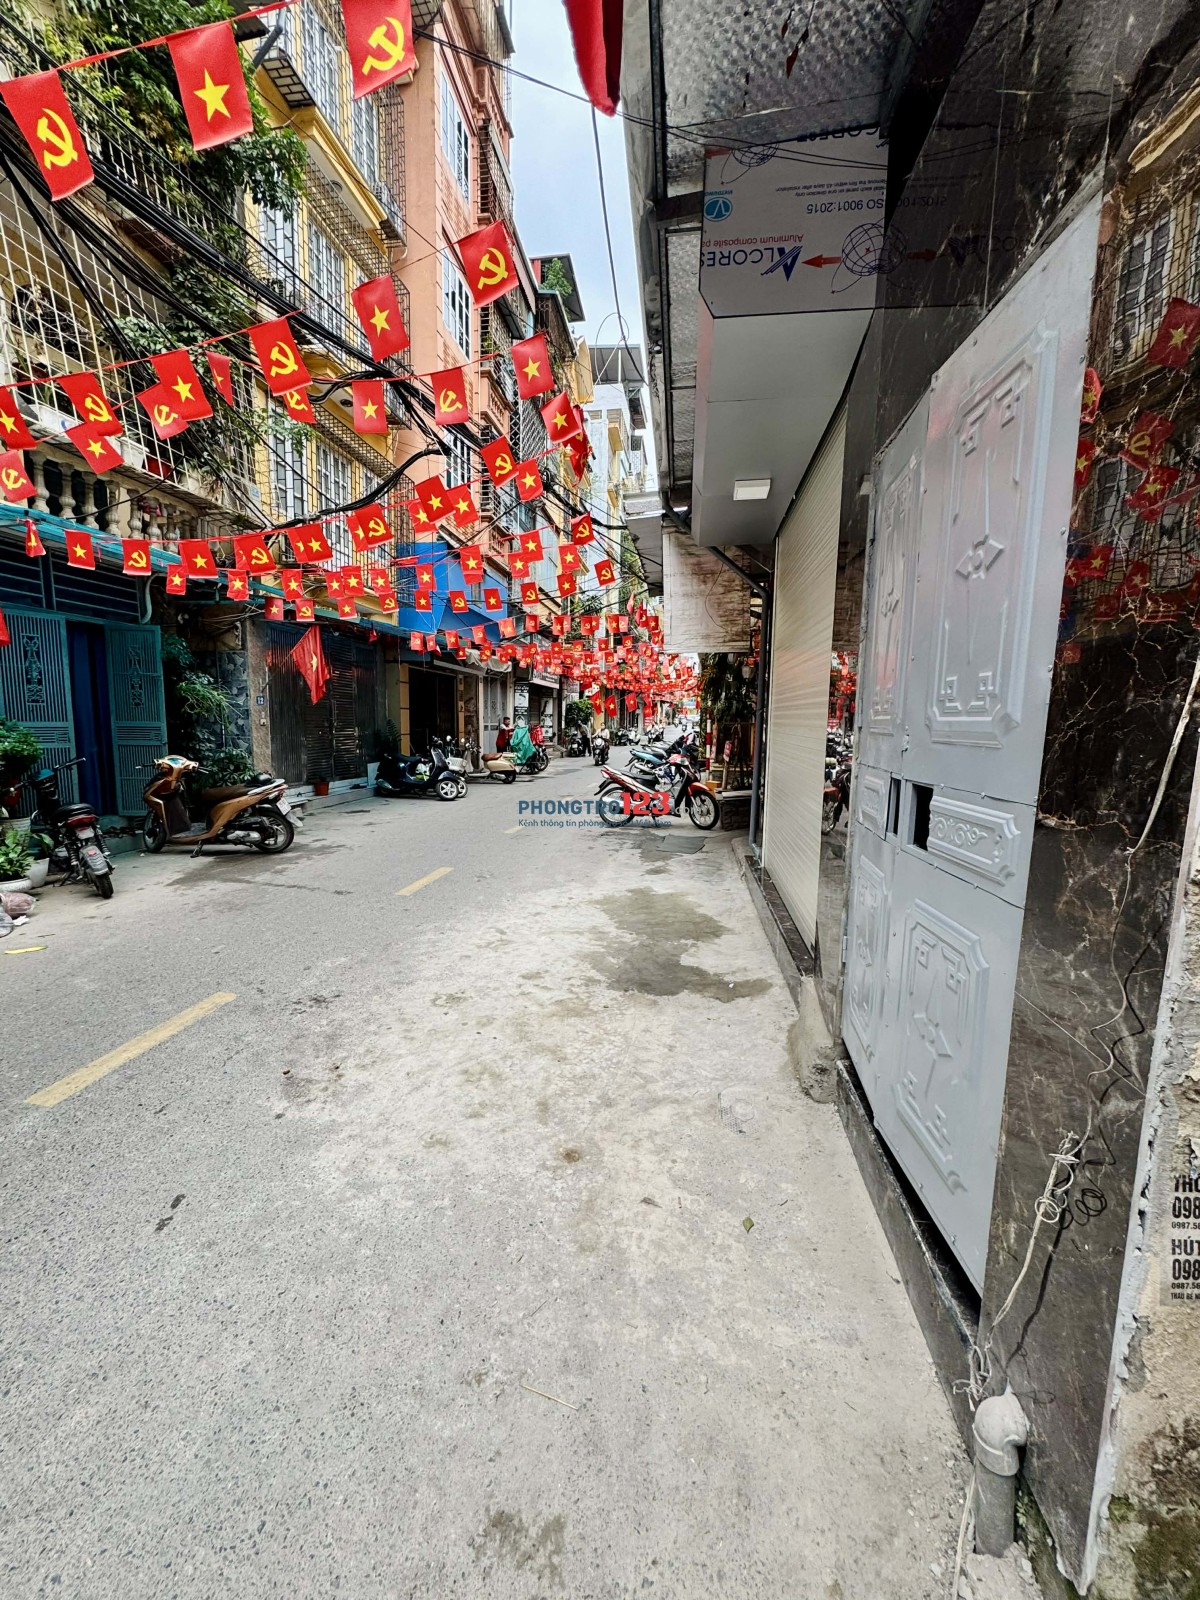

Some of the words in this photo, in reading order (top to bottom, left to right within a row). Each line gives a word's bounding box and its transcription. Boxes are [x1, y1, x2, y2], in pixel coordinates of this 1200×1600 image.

[806, 200, 864, 214] 9001:2015
[713, 237, 758, 248] composite
[760, 234, 804, 244] Aluminum
[1172, 1196, 1200, 1219] 098
[1172, 1258, 1200, 1280] 098
